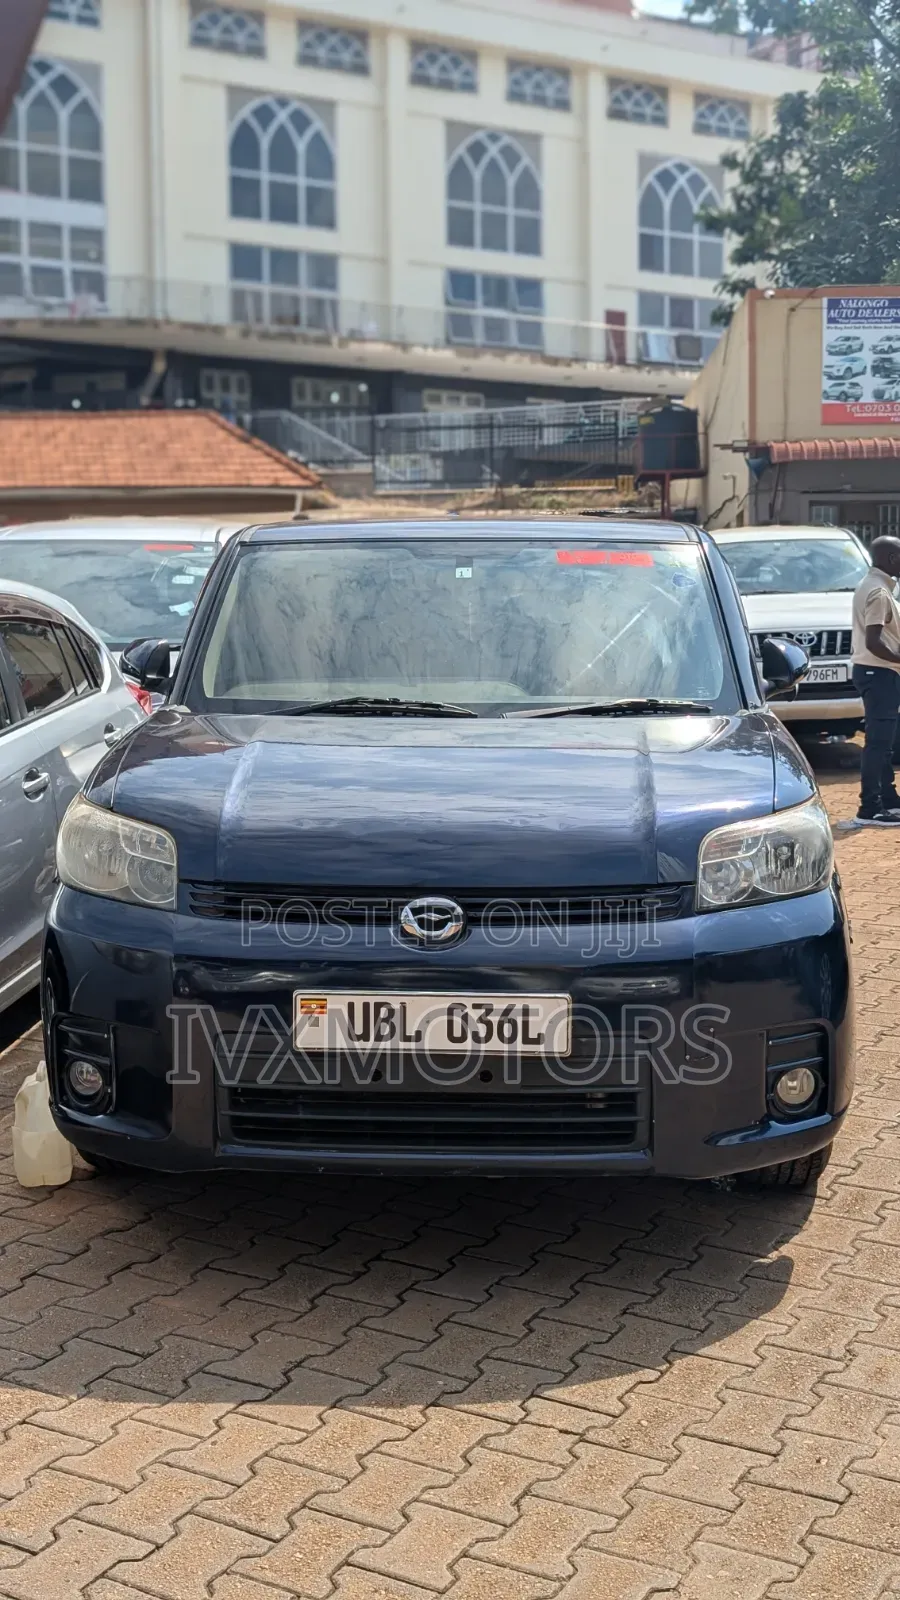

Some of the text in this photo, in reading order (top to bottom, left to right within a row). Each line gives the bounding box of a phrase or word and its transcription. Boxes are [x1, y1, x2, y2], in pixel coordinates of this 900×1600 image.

[838, 299, 889, 308] NALONGO
[828, 308, 900, 318] AUTO DEALERS
[347, 1001, 546, 1046] UBL 036L
